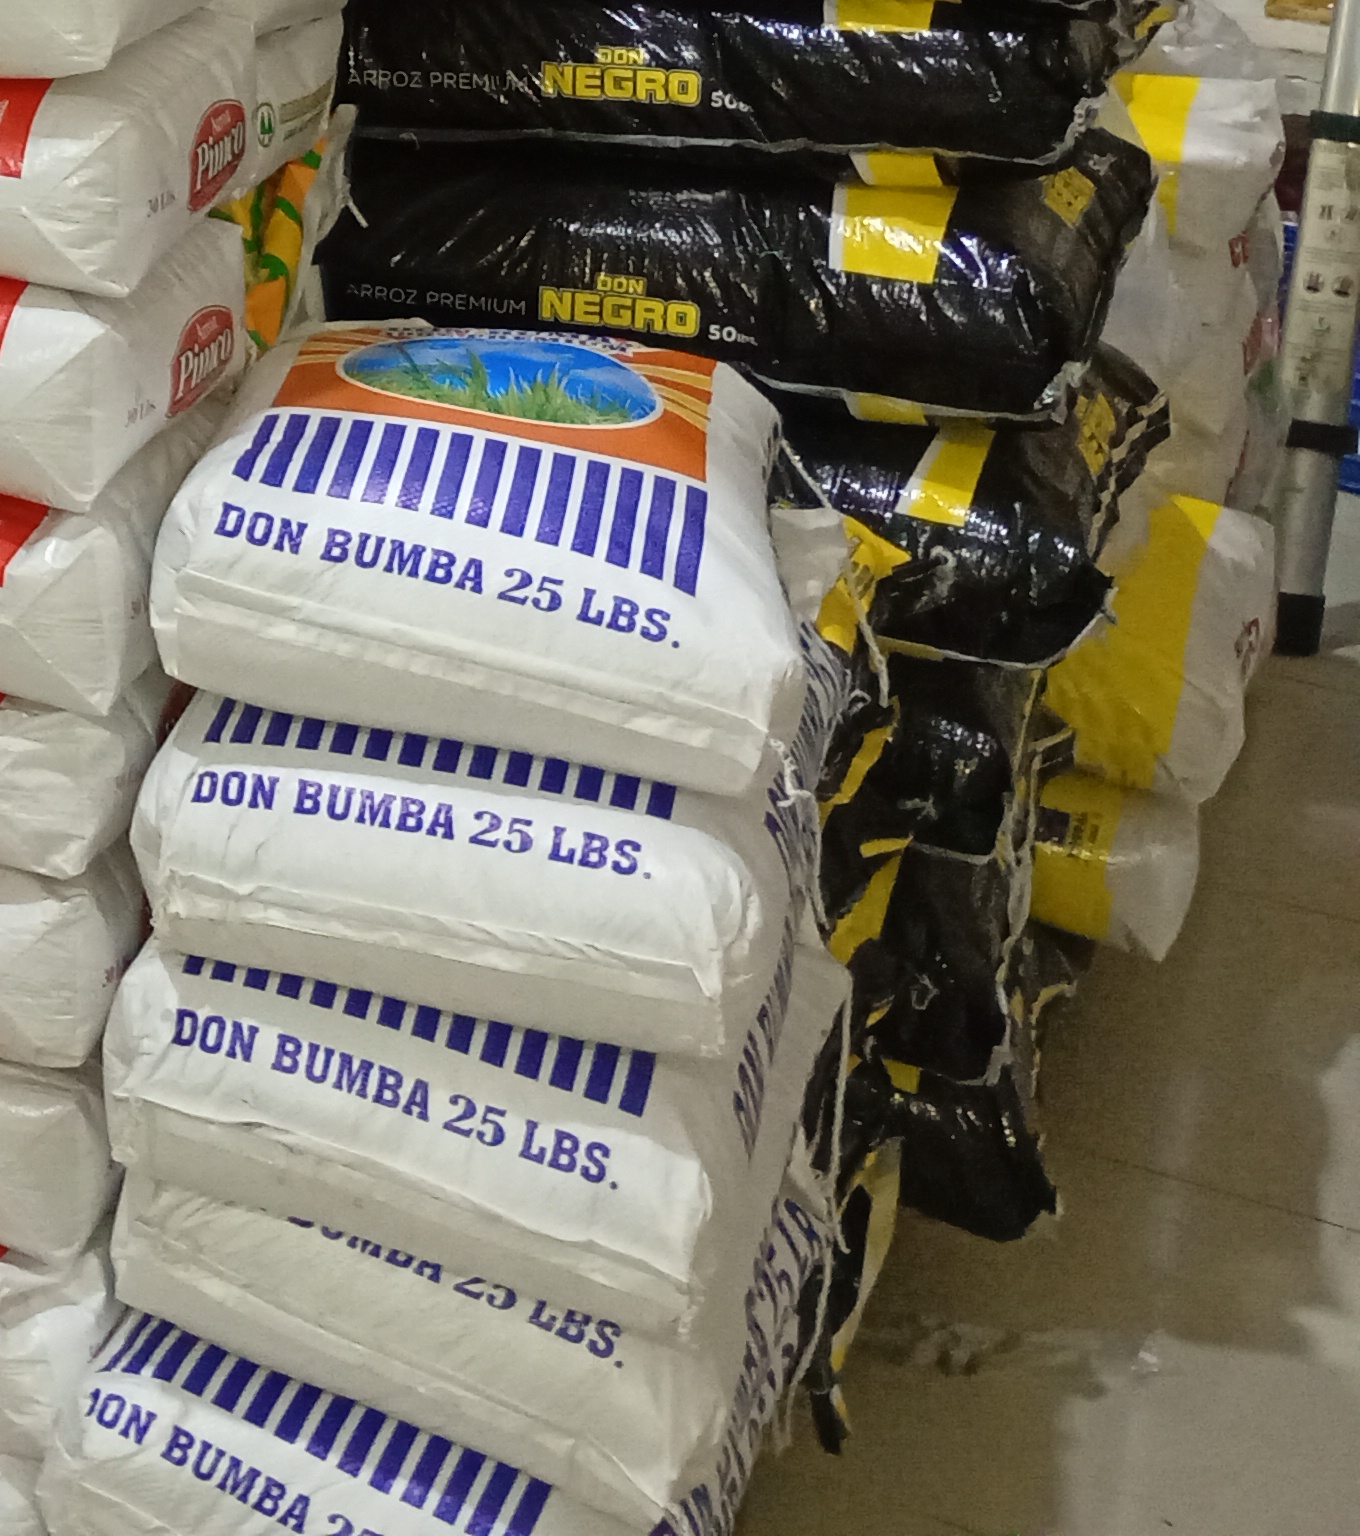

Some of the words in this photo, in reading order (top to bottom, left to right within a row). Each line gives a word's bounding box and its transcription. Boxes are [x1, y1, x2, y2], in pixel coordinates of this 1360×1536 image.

[347, 70, 422, 89] ARROZ
[541, 61, 702, 107] NEGRO
[597, 46, 646, 65] DON
[427, 292, 525, 315] PREMIUM
[538, 286, 700, 337] NEGRO
[595, 273, 646, 295] DON
[213, 502, 309, 555] DON
[320, 528, 484, 594] BUMBA
[496, 568, 562, 612] 25
[576, 596, 681, 649] LBS.
[191, 770, 279, 810] DON
[292, 779, 455, 840] BUMBA
[469, 810, 535, 854] 25
[548, 826, 652, 879] LBS.
[171, 1008, 260, 1062] DON
[270, 1039, 431, 1122] BUMBA
[442, 1093, 506, 1148] 25
[519, 1119, 619, 1190] LBS.
[161, 1427, 313, 1535] BUMBA
